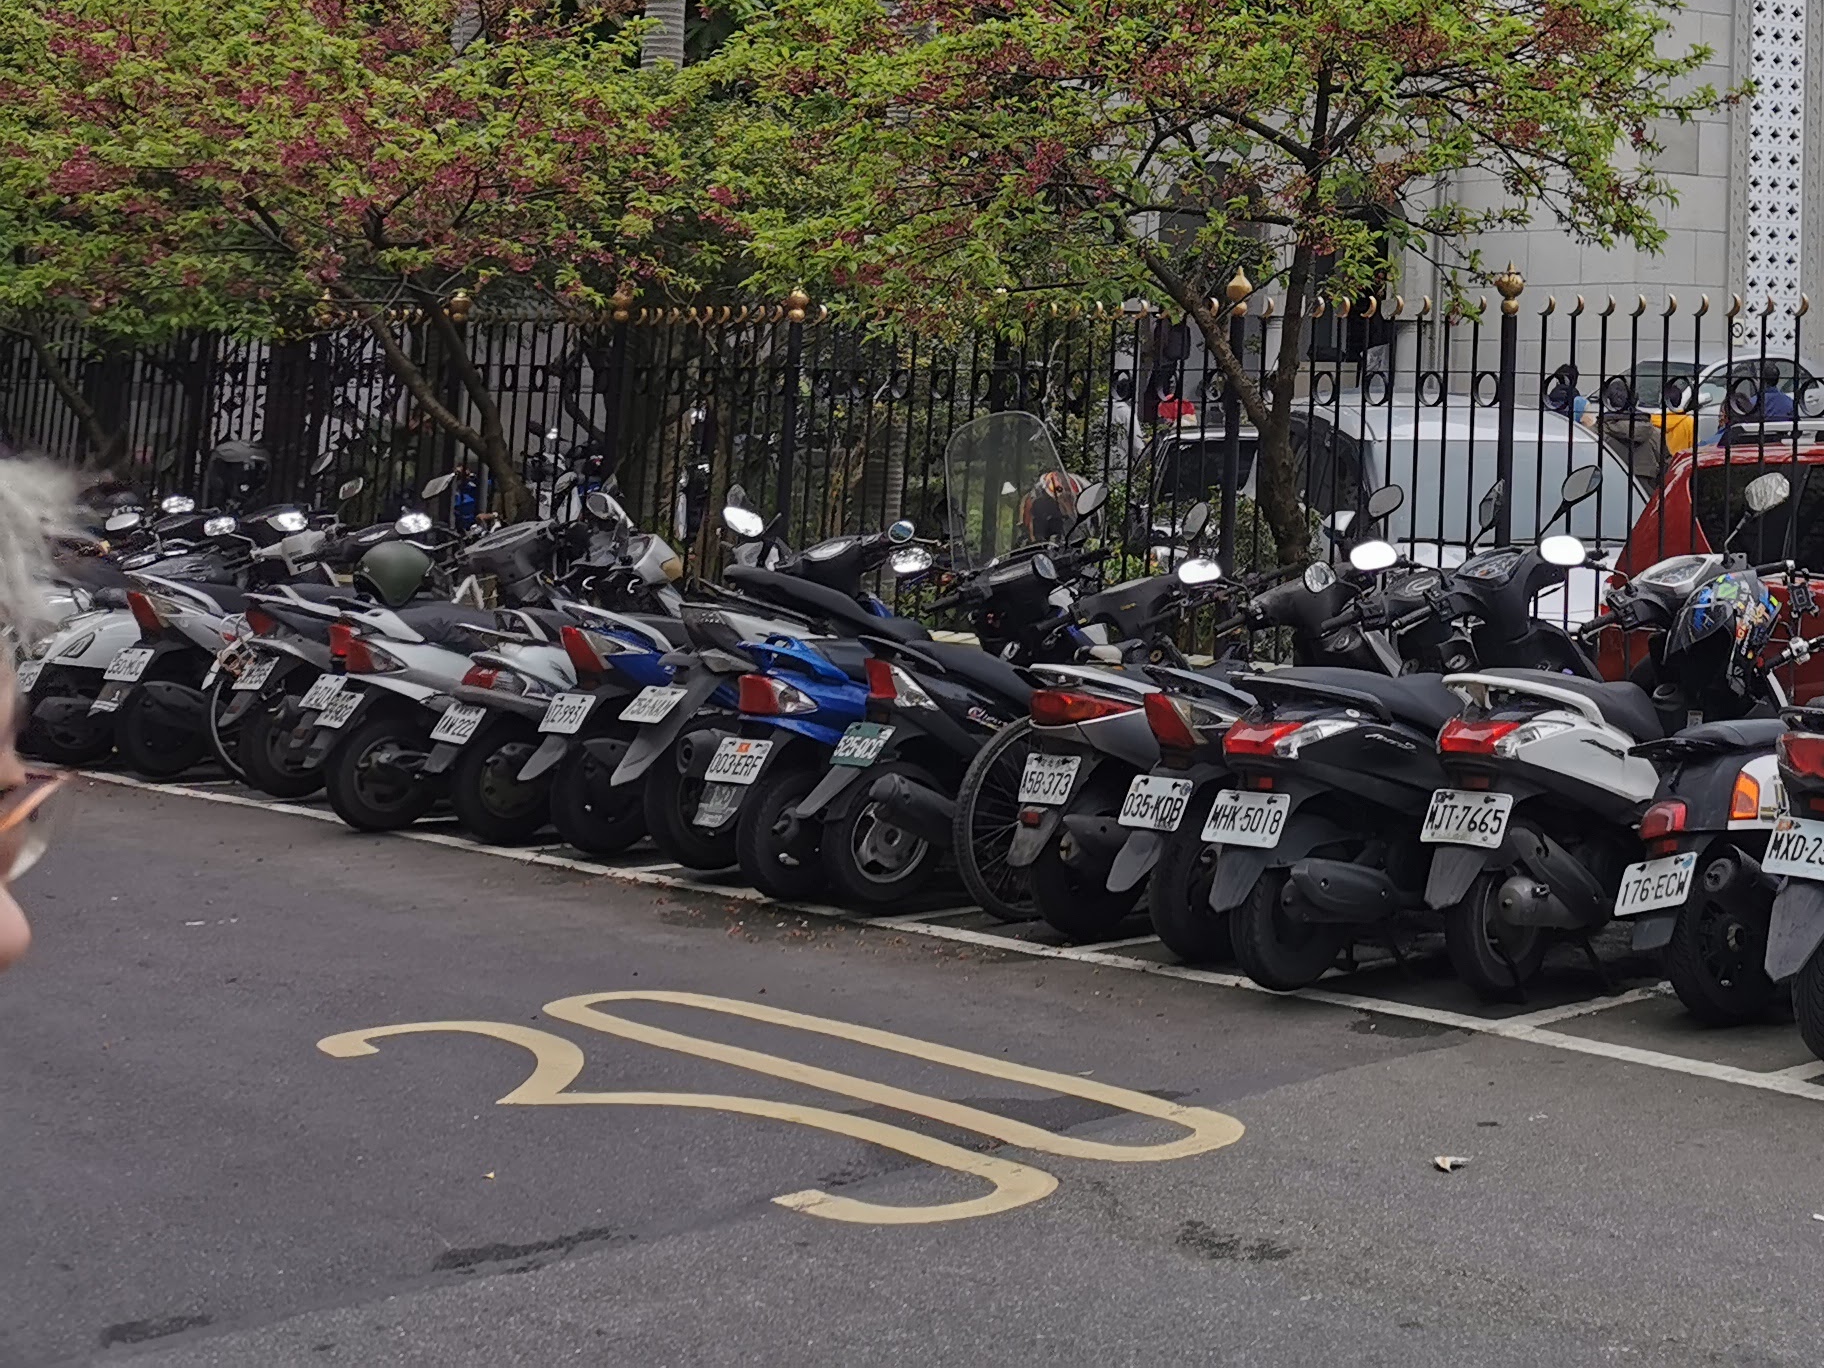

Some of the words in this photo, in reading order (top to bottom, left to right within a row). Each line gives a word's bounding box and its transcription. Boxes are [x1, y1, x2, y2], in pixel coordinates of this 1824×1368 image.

[710, 753, 763, 777] 003-ERF
[1123, 793, 1184, 821] 035-KDB
[1208, 804, 1283, 835] MHK-5018
[1426, 804, 1505, 835] MJT-7665
[1621, 870, 1689, 907] 176-ECW
[317, 990, 1246, 1225] 30
